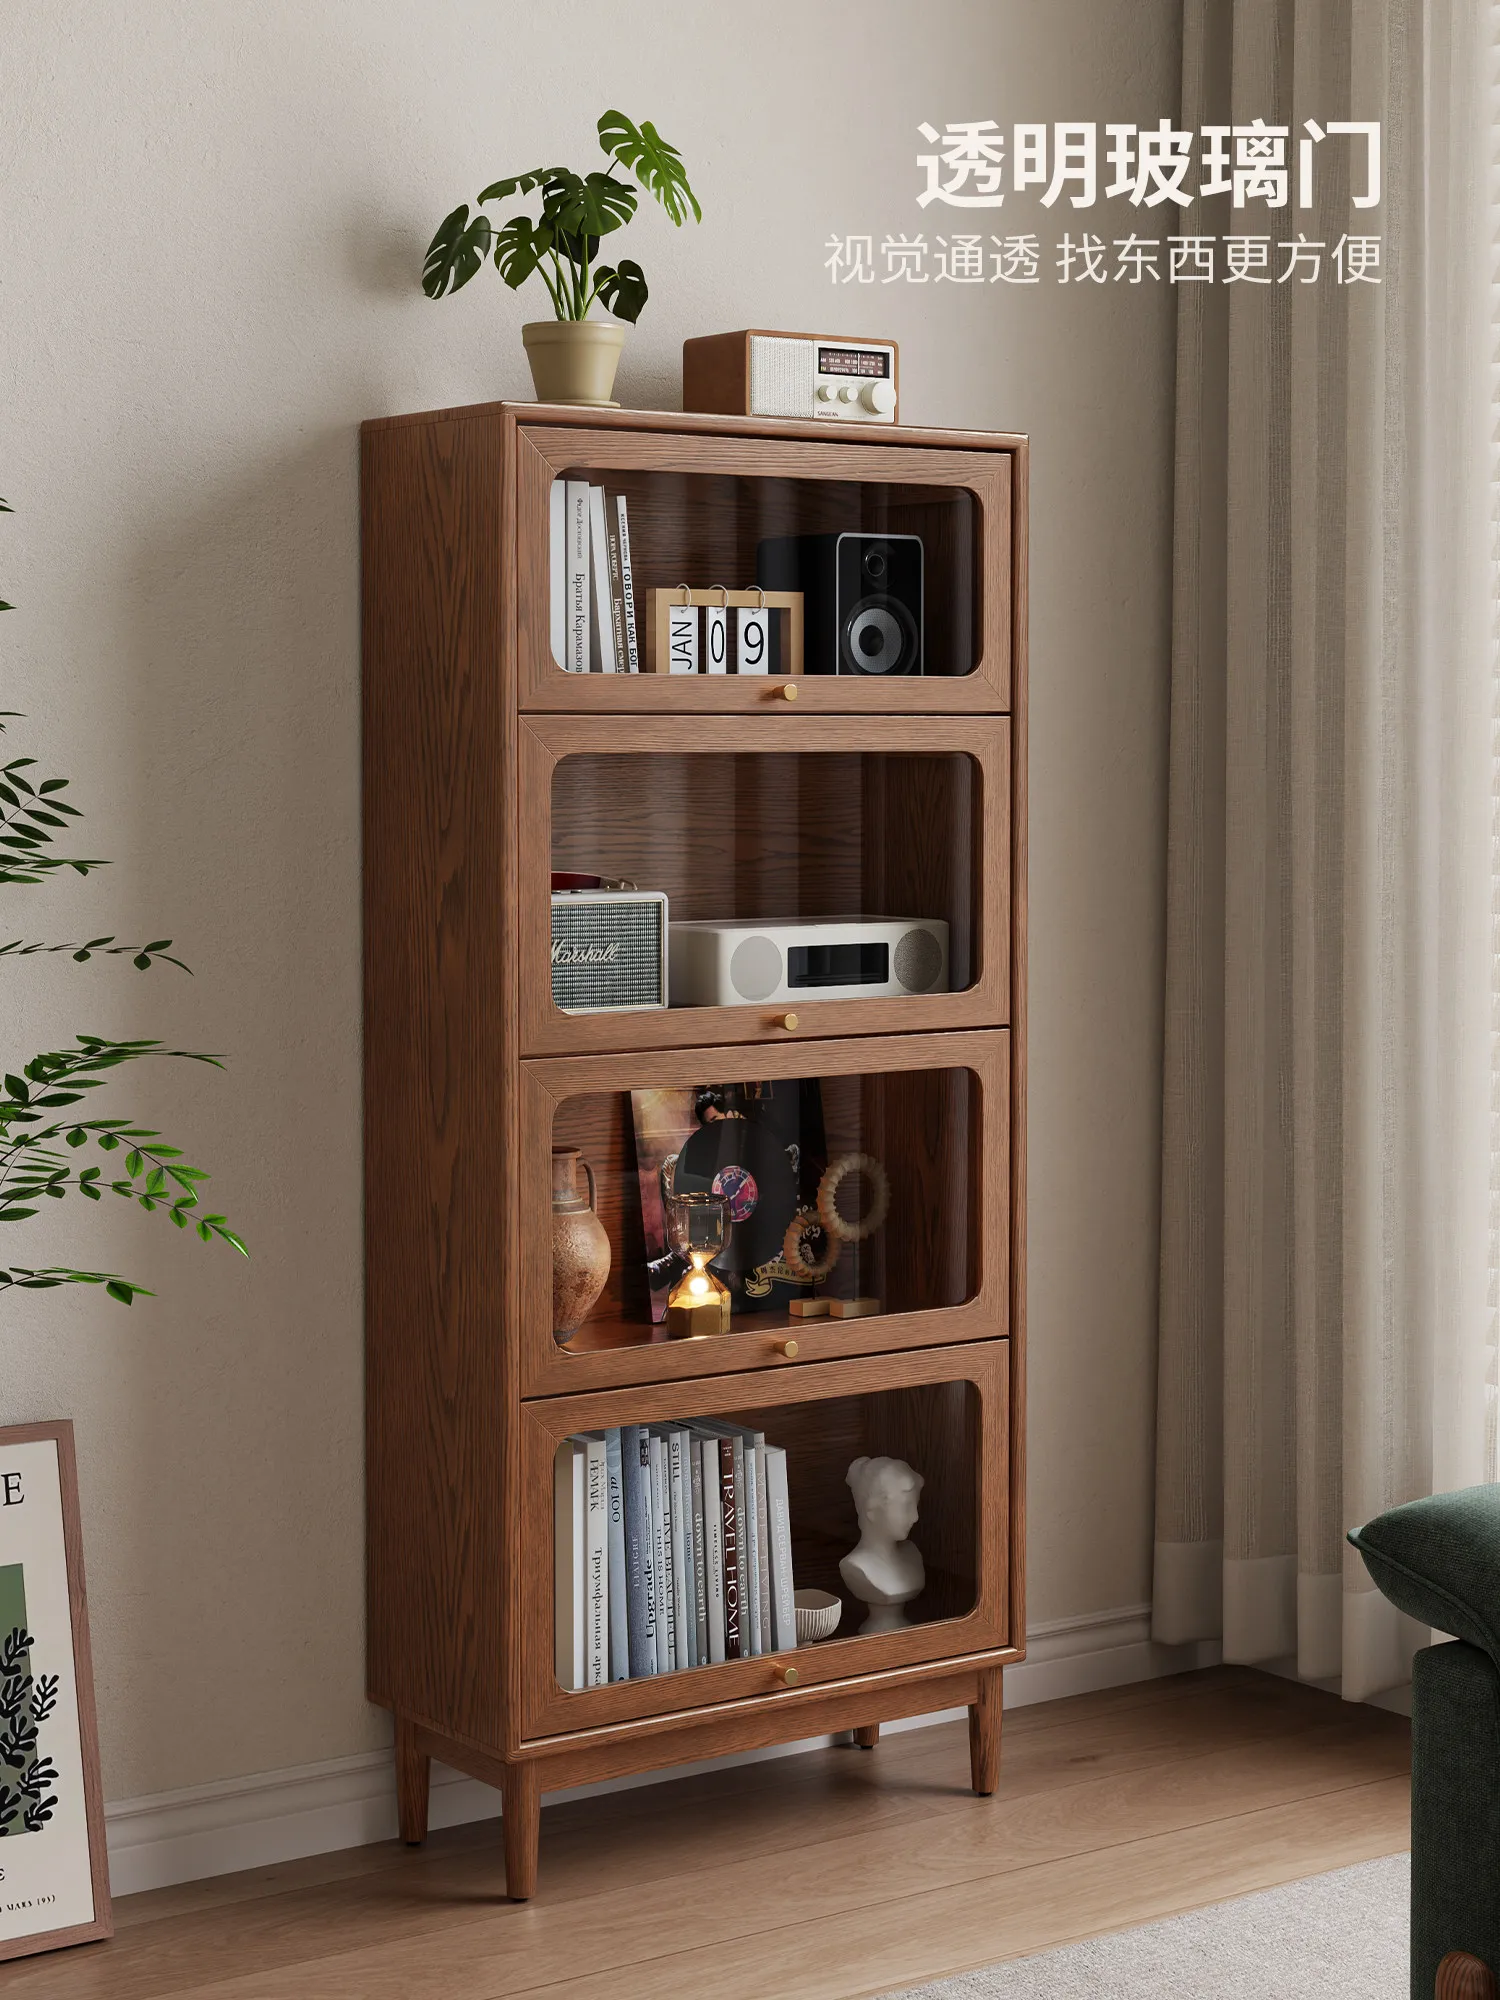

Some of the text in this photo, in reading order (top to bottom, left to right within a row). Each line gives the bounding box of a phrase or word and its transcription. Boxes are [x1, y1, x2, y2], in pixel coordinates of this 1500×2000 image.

[572, 573, 585, 673] Братья Карамазов
[613, 598, 624, 649] Бархатная
[623, 566, 638, 668] ГОВОРИ КАК БОГ
[671, 620, 693, 670] JAN
[743, 621, 765, 666] 9
[551, 939, 620, 963] Marshall
[590, 1459, 600, 1512] РЕМАРК
[610, 1476, 619, 1492] at
[672, 1442, 680, 1483] STILL
[611, 1495, 621, 1523] 100
[723, 1468, 737, 1559] TRAVEL
[775, 1499, 785, 1533] ДАВИД
[657, 1560, 664, 1573] IS
[663, 1512, 675, 1655] LIVE BEAUTIFUL
[694, 1512, 706, 1623] down to earth
[737, 1507, 748, 1616] down to earth
[760, 1555, 769, 1630] LIVING
[592, 1546, 603, 1686] Триумфальная арка
[644, 1559, 656, 1638] Upgrade
[726, 1566, 740, 1648] HOME
